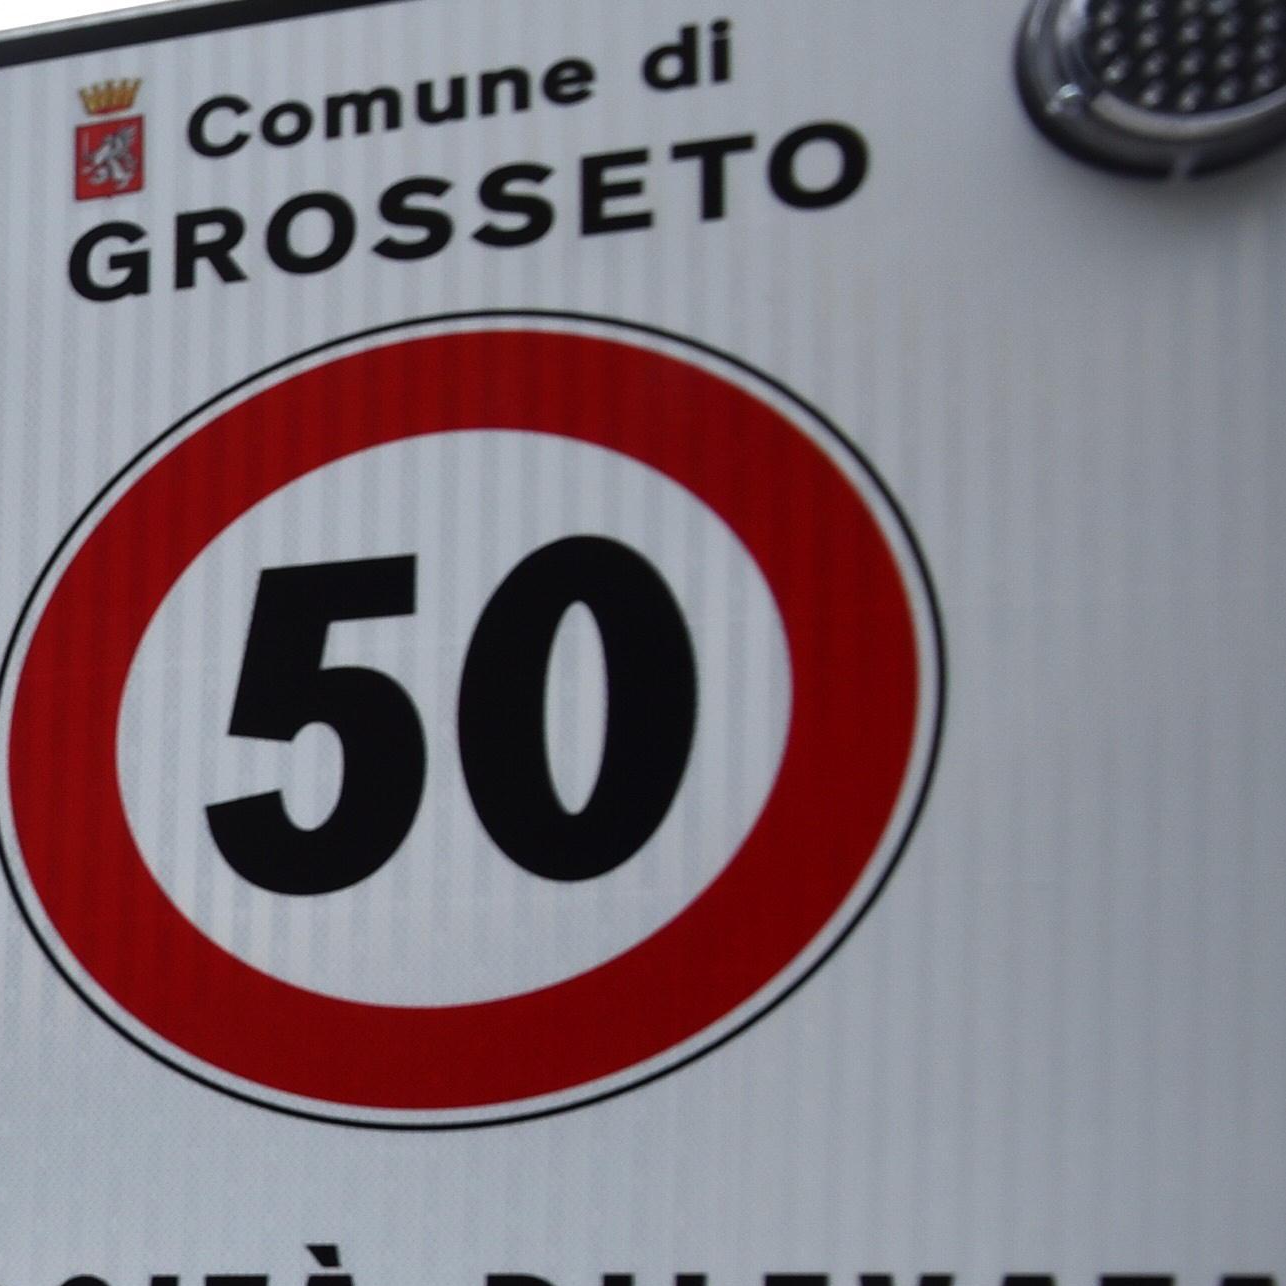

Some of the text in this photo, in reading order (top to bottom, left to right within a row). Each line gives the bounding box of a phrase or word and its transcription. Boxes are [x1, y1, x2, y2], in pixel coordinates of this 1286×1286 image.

[187, 18, 732, 160] Comune di
[67, 121, 871, 303] GROSSETO
[204, 534, 699, 897] 50
